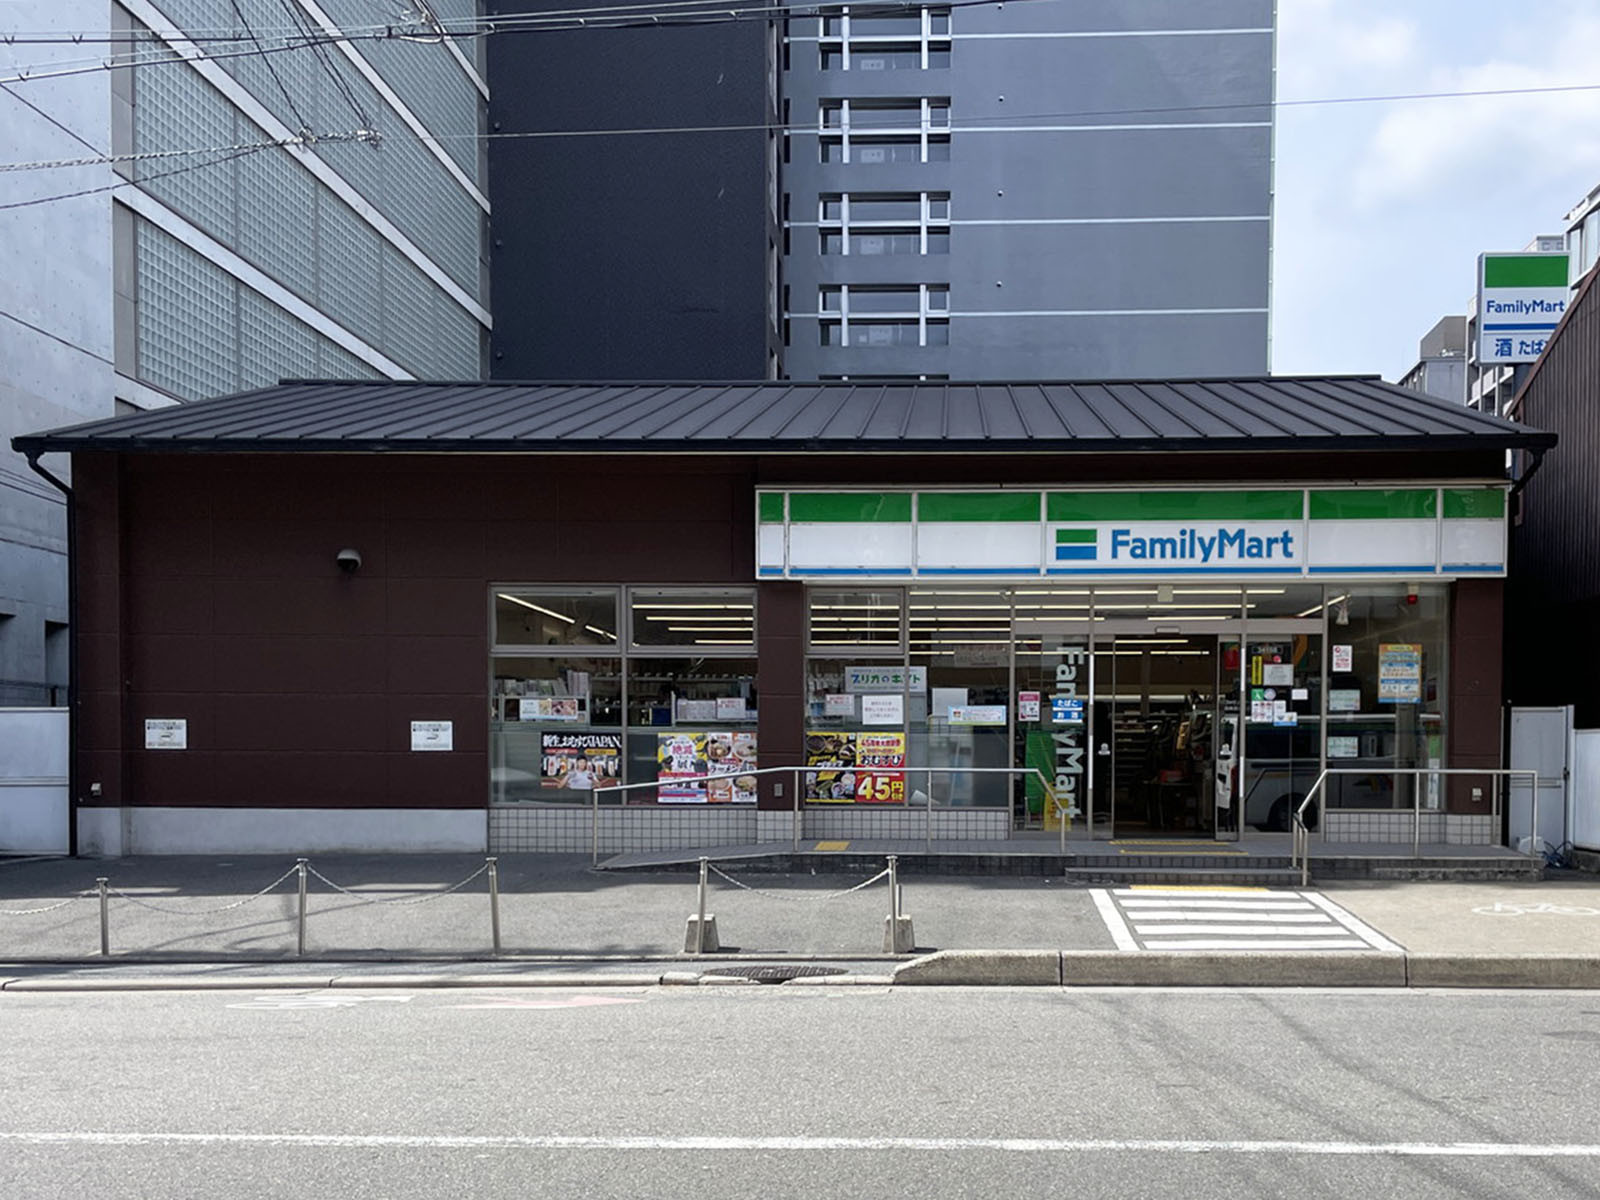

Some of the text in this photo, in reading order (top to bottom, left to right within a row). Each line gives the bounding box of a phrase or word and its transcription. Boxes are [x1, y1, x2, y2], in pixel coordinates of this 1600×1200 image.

[1486, 299, 1565, 315] FamilyMart
[1494, 338, 1548, 357] 酒 たば
[1111, 528, 1294, 562] FamilyMart
[1056, 699, 1079, 707] たばこ
[1052, 646, 1084, 818] FamyMart
[861, 755, 902, 766] おむすび
